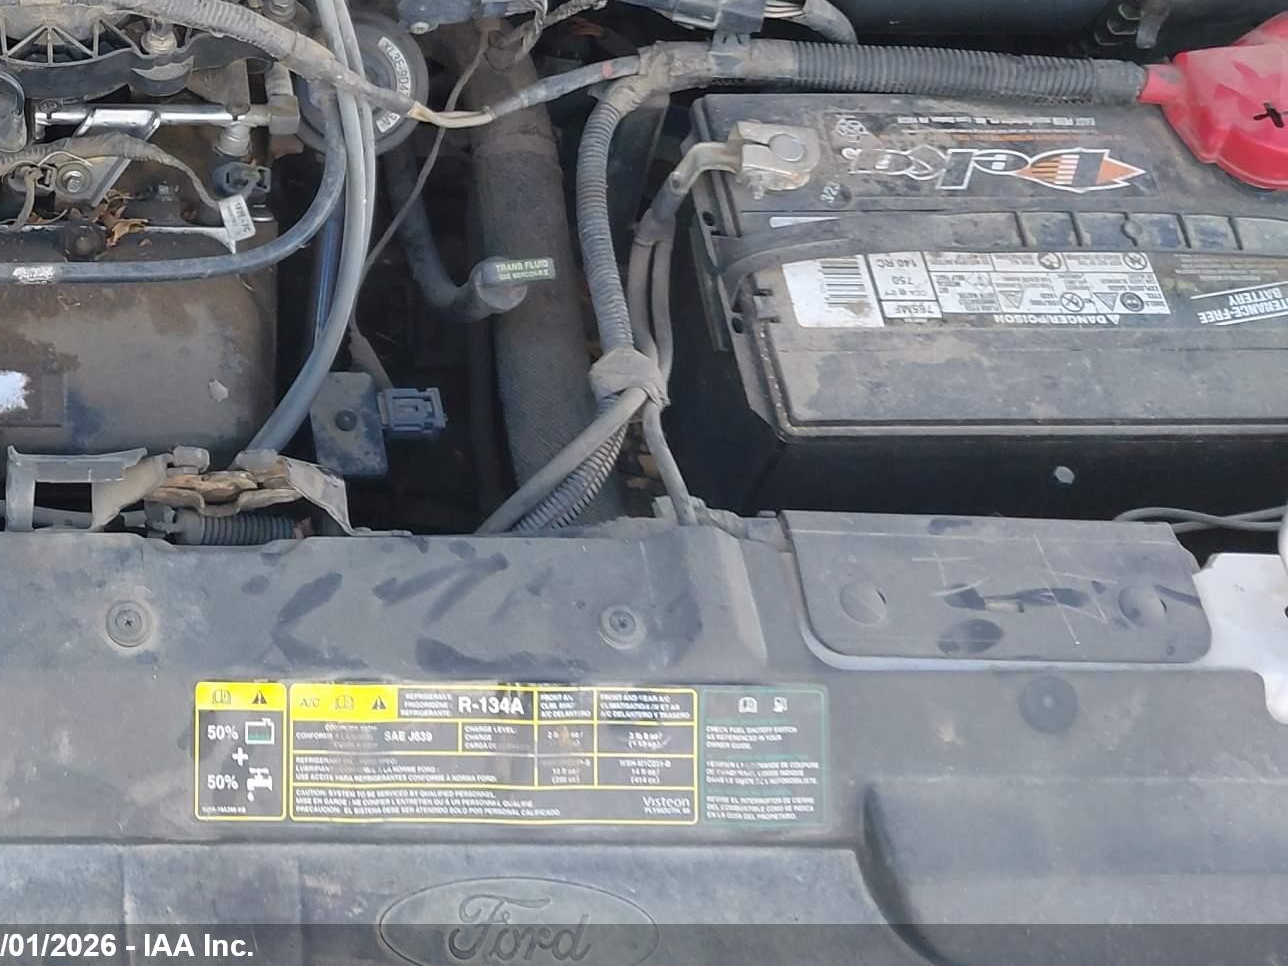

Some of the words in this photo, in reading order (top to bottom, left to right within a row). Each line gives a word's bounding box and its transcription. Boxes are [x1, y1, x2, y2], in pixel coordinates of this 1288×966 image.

[495, 261, 523, 273] TRANS
[524, 259, 549, 270] FLUID
[876, 258, 895, 268] RC
[1228, 287, 1283, 306] BATTERY
[993, 313, 1108, 325] DANGER/POISON
[605, 344, 619, 369] SAE
[605, 371, 619, 415] 5W-20
[299, 697, 321, 708] A/C
[457, 695, 525, 715] R-134A
[207, 724, 239, 740] 50%
[383, 730, 407, 743] SAE
[207, 774, 239, 790] 50%
[642, 796, 690, 808] Visteon
[447, 893, 592, 961] Ford
